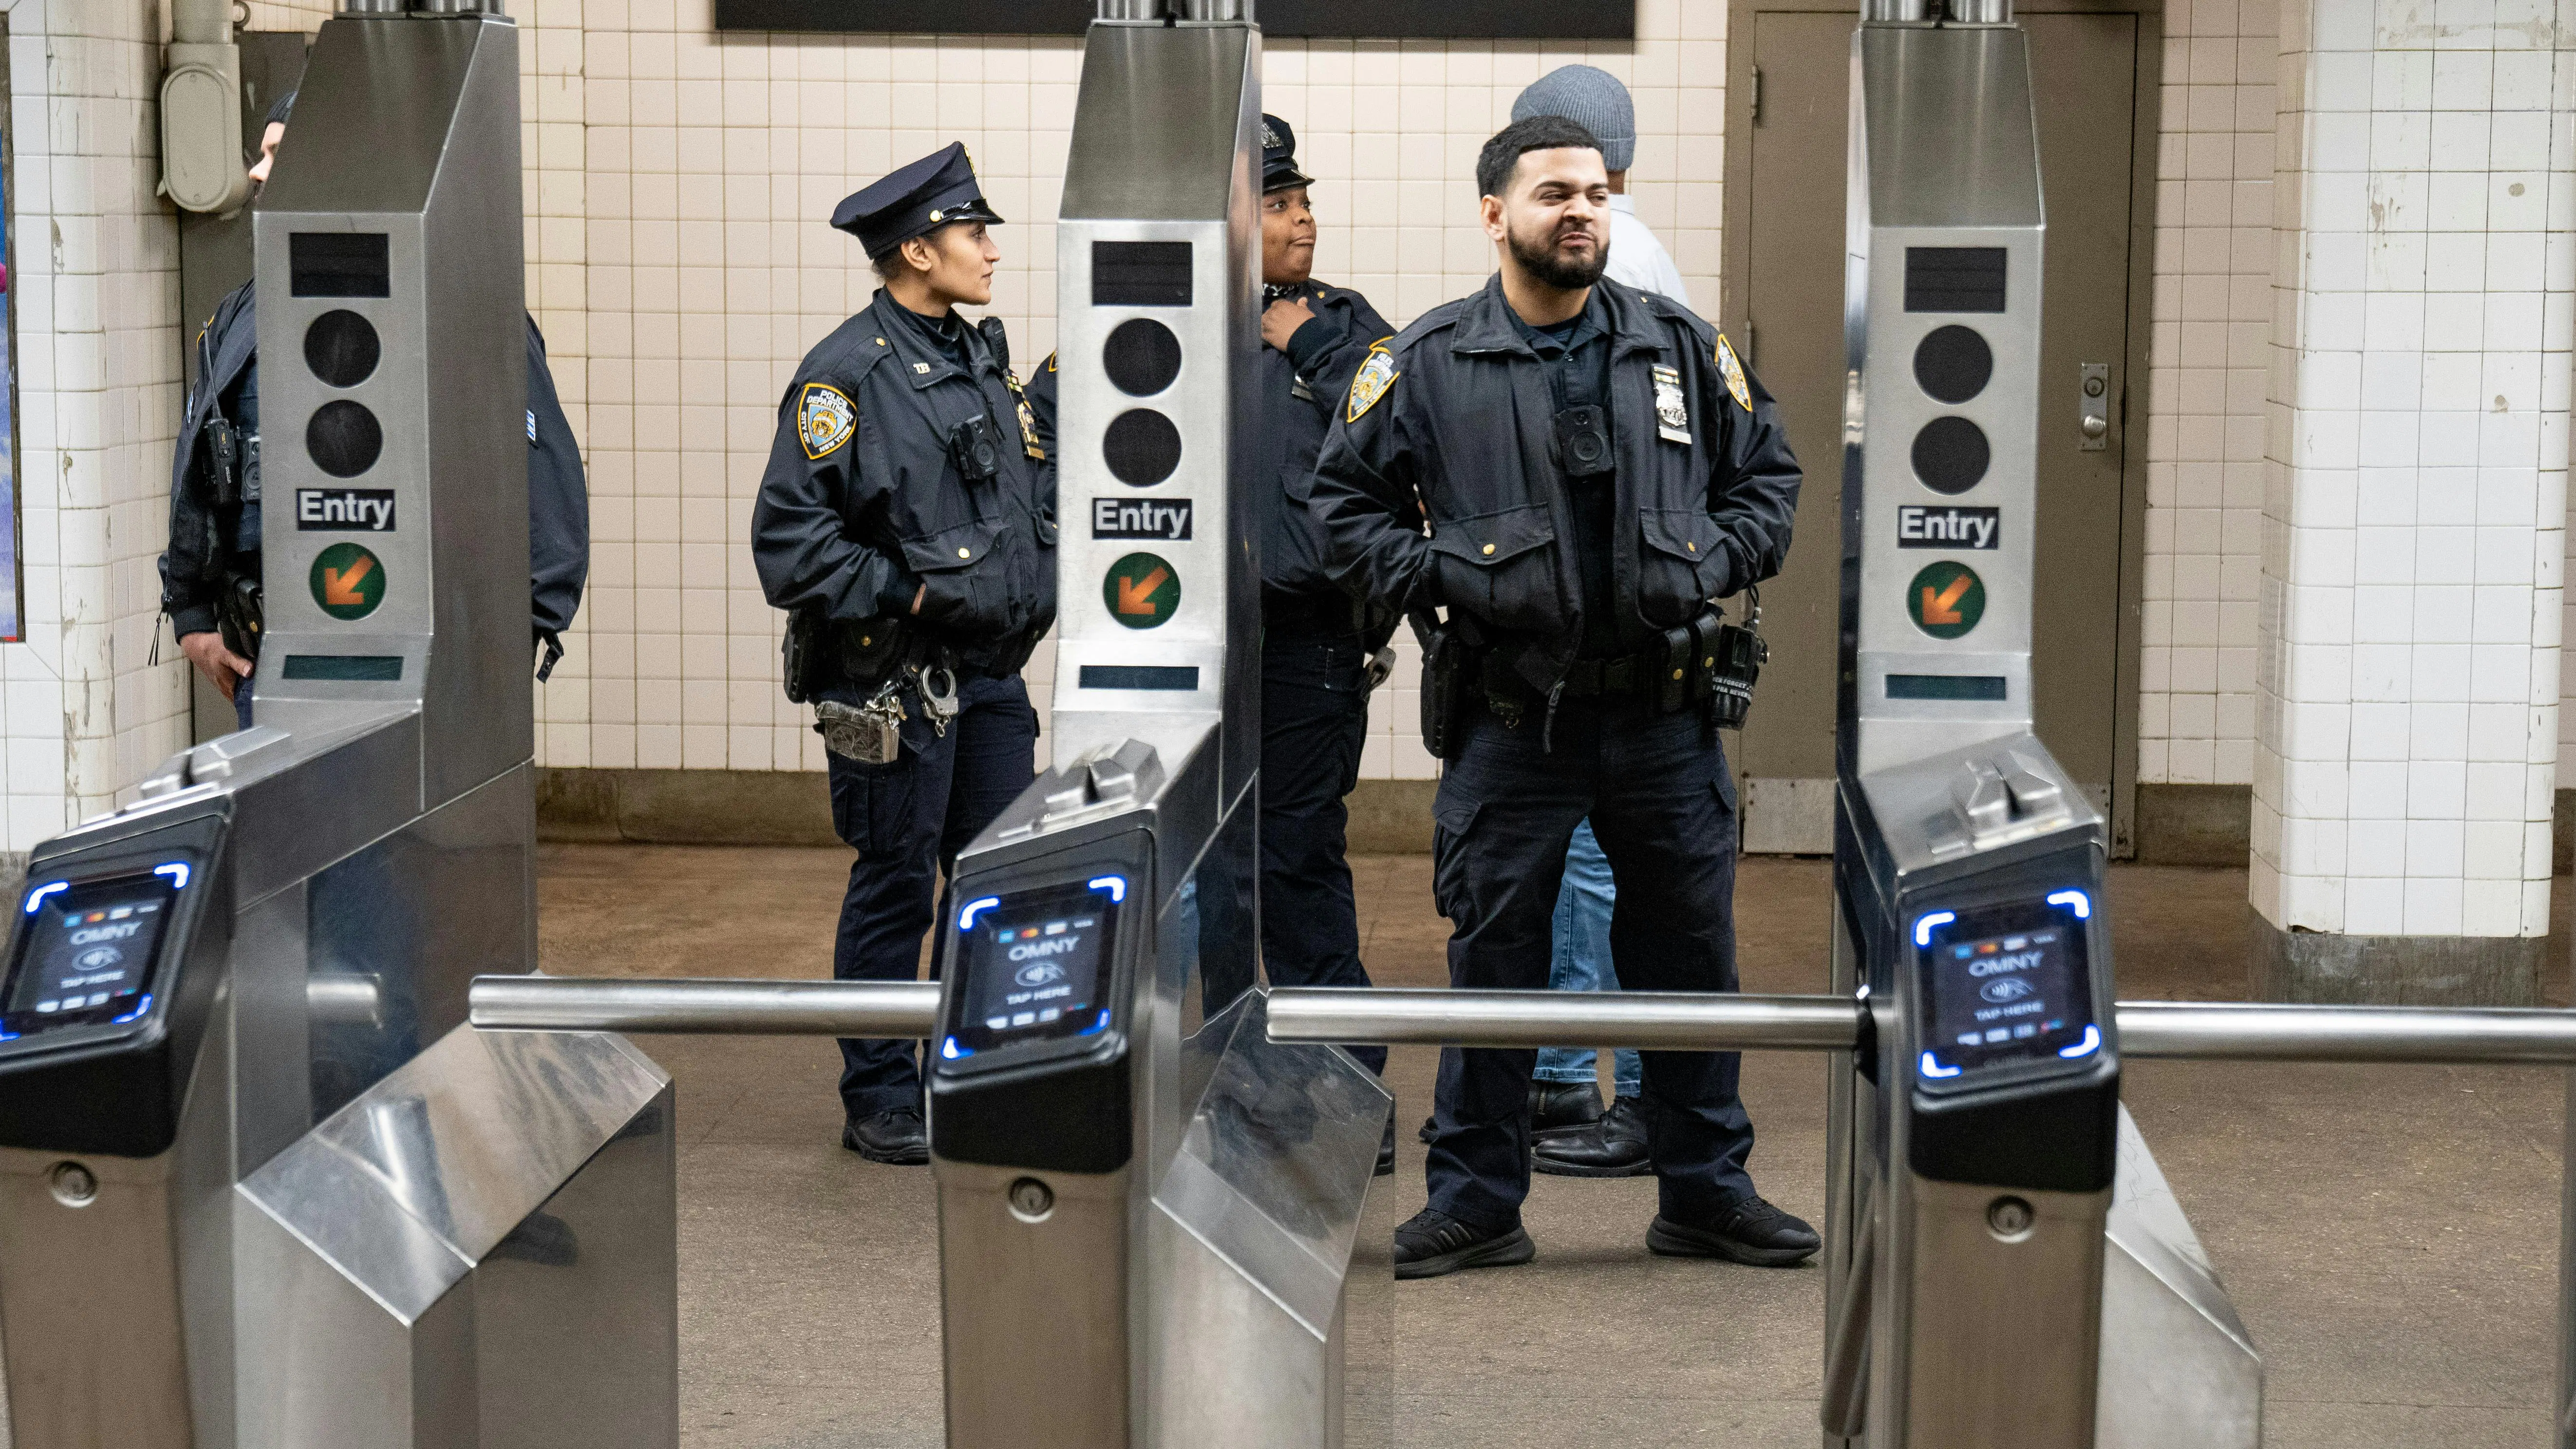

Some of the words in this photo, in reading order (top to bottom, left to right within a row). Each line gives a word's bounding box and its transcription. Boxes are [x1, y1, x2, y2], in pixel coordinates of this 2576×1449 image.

[807, 396, 853, 421] DEPARTMENT
[821, 391, 847, 408] POLICE
[804, 433, 810, 444] OF
[819, 441, 835, 452] NEW
[835, 425, 852, 442] YORK
[300, 491, 393, 530] Entry
[1095, 500, 1188, 539] Entry
[1900, 508, 1995, 548] Entry
[1008, 936, 1080, 961] OMNY
[1968, 951, 2044, 977] OMNY
[1974, 1008, 2001, 1022] TAP
